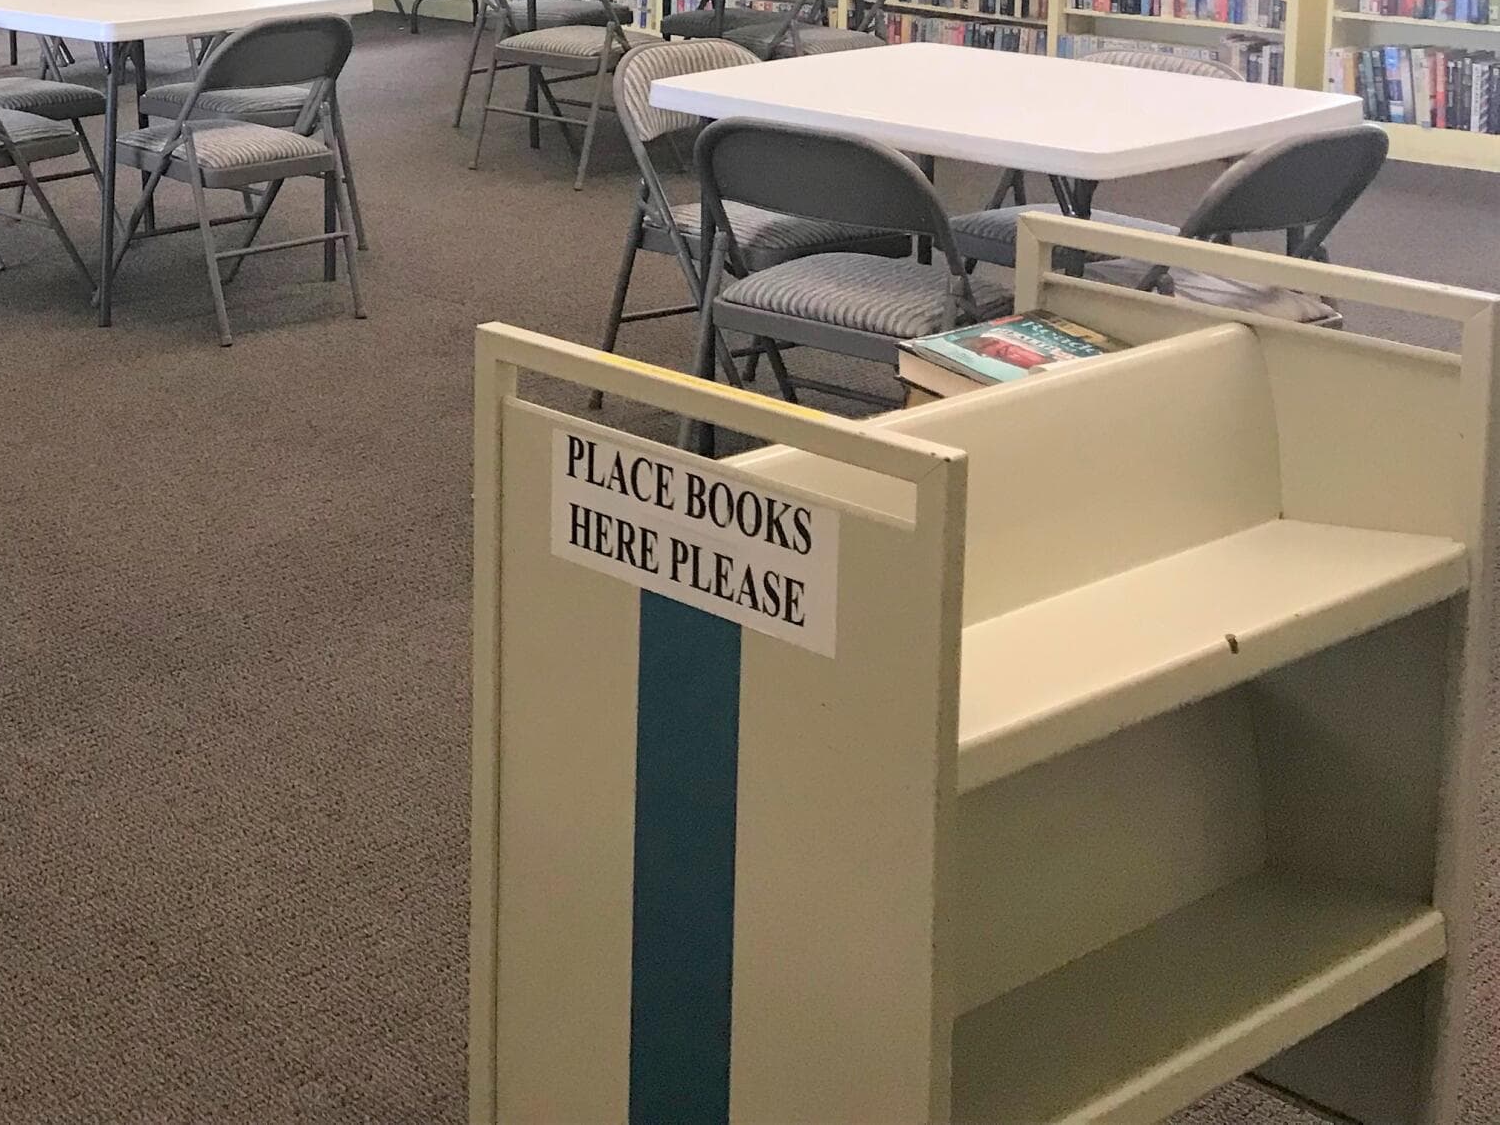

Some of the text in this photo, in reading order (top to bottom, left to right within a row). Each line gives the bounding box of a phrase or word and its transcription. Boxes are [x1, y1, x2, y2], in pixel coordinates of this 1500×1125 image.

[566, 434, 812, 556] PLACE BOOKS
[569, 502, 805, 628] HERE PLEASE
